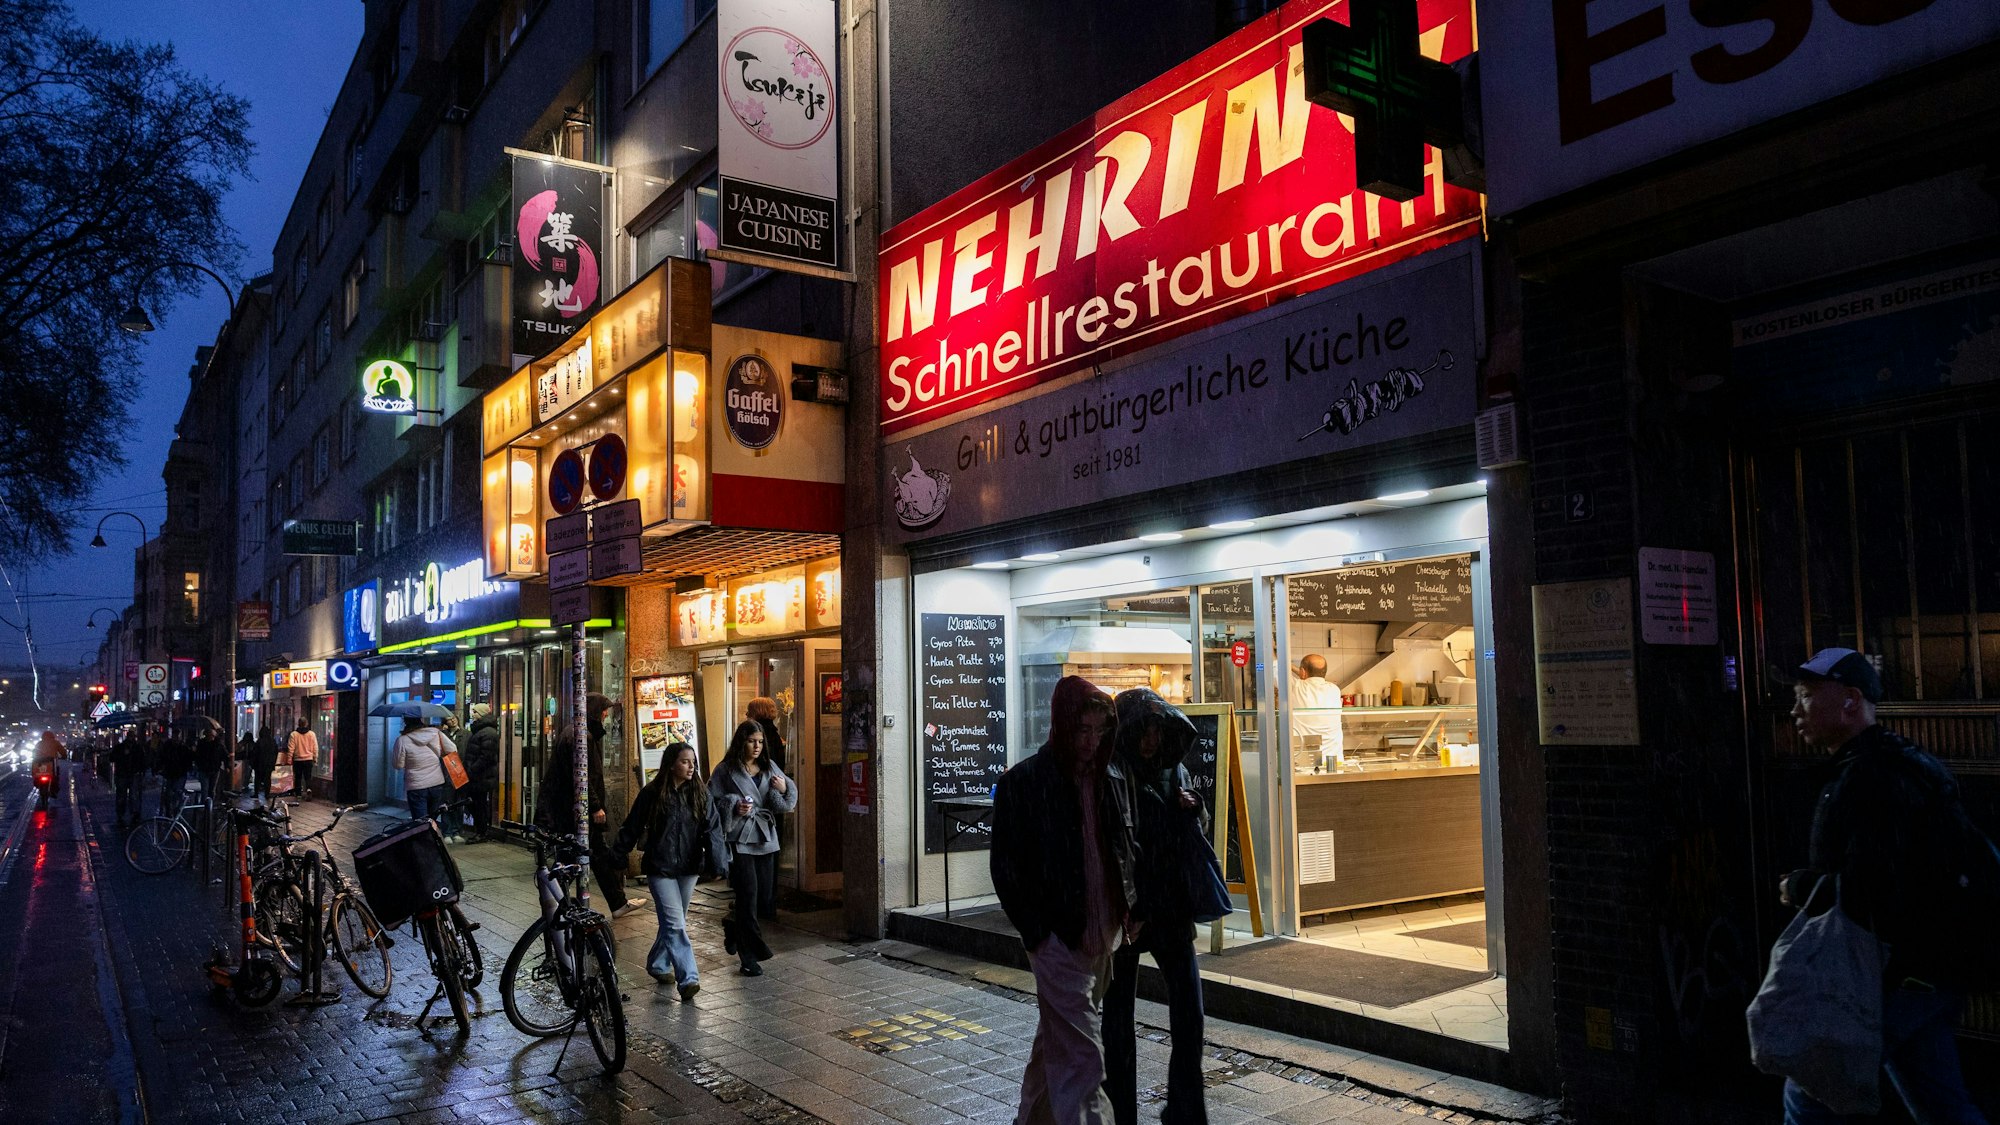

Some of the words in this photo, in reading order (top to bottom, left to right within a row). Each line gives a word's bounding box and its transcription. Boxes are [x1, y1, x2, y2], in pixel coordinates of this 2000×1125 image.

[1554, 0, 1939, 145] ES
[885, 22, 1447, 342] NEHRIN
[729, 194, 820, 229] JAPANESE
[748, 219, 811, 250] CUISINE
[1742, 297, 1876, 340] KOSTENLOSER
[957, 425, 1005, 472] Grill
[1015, 421, 1030, 455] &
[1039, 356, 1269, 457] gutbürgerliche
[1286, 313, 1410, 376] Küche
[728, 388, 779, 414] Gaffel
[737, 411, 769, 427] Kölsch
[1073, 457, 1099, 480] seit
[1106, 443, 1141, 473] 1981
[1572, 493, 1585, 518] 2
[322, 524, 354, 535] CELLER
[549, 525, 585, 541] Ladezone
[1206, 602, 1221, 612] Taxi
[1222, 603, 1241, 613] Teller
[930, 636, 953, 651] Gyros
[955, 635, 976, 647] Pita
[988, 636, 1003, 648] 7,90
[957, 653, 983, 665] Platte
[989, 653, 1005, 665] 8,40
[293, 672, 318, 684] KIOSK
[930, 674, 954, 688] Gyros
[958, 673, 983, 685] Teller
[929, 696, 950, 709] Taxi
[951, 695, 978, 708] Teller
[980, 699, 992, 708] XL
[987, 710, 1005, 722] 13,90
[936, 724, 989, 741] Jägerschnitzel
[931, 742, 946, 752] mit
[950, 739, 981, 752] Pommes
[931, 756, 978, 769] Schaschlik
[934, 769, 950, 778] mit
[953, 766, 986, 777] Pommes
[933, 782, 958, 795] Salat
[960, 781, 990, 794] Tasche
